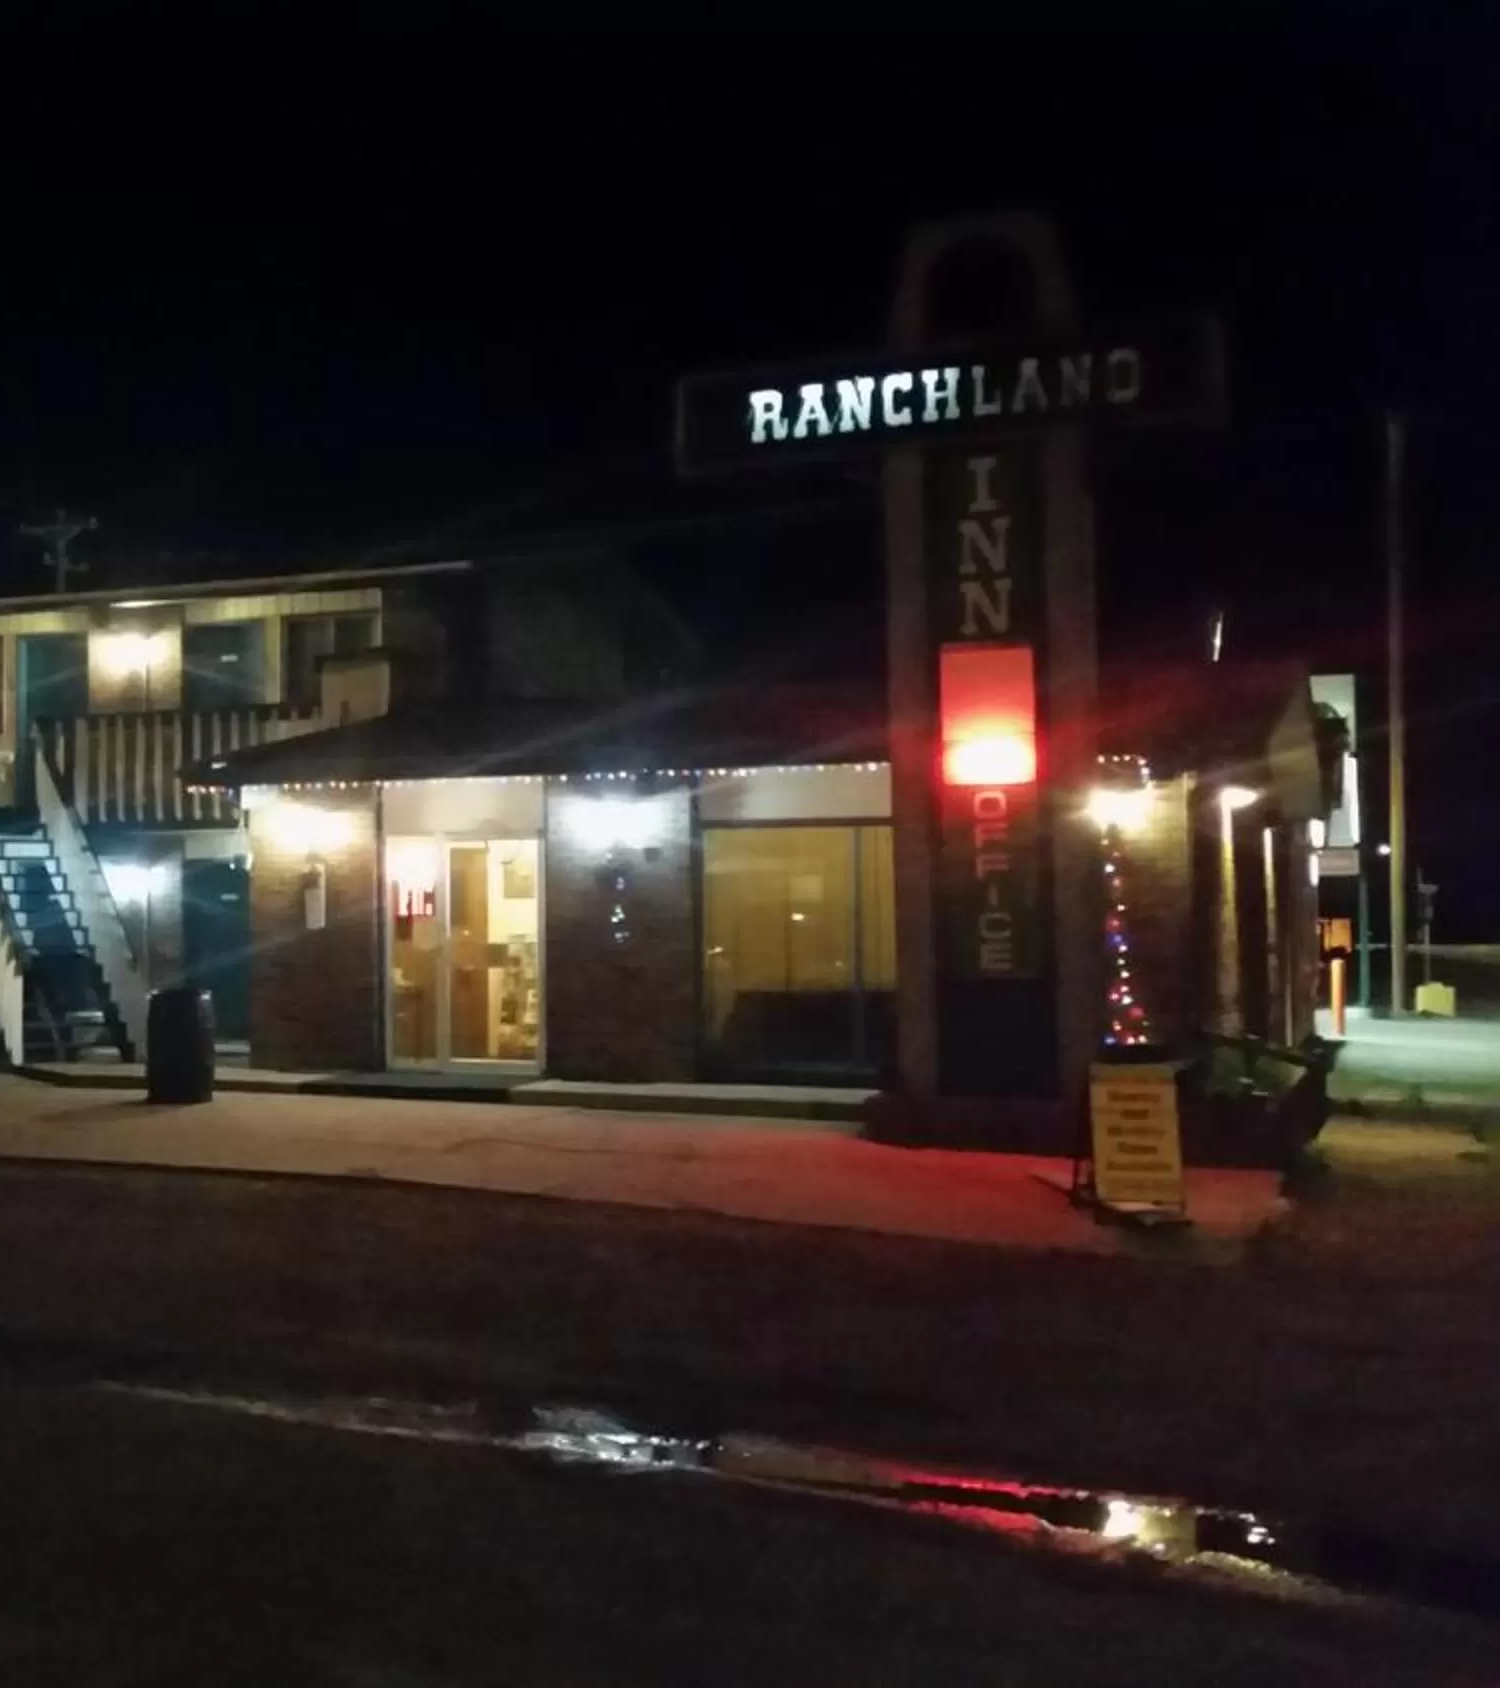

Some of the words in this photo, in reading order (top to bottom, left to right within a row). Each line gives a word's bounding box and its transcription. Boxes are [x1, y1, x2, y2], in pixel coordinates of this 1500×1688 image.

[748, 347, 1142, 444] RANCHLAND
[958, 455, 1012, 637] INN
[973, 790, 1013, 971] OFFICE
